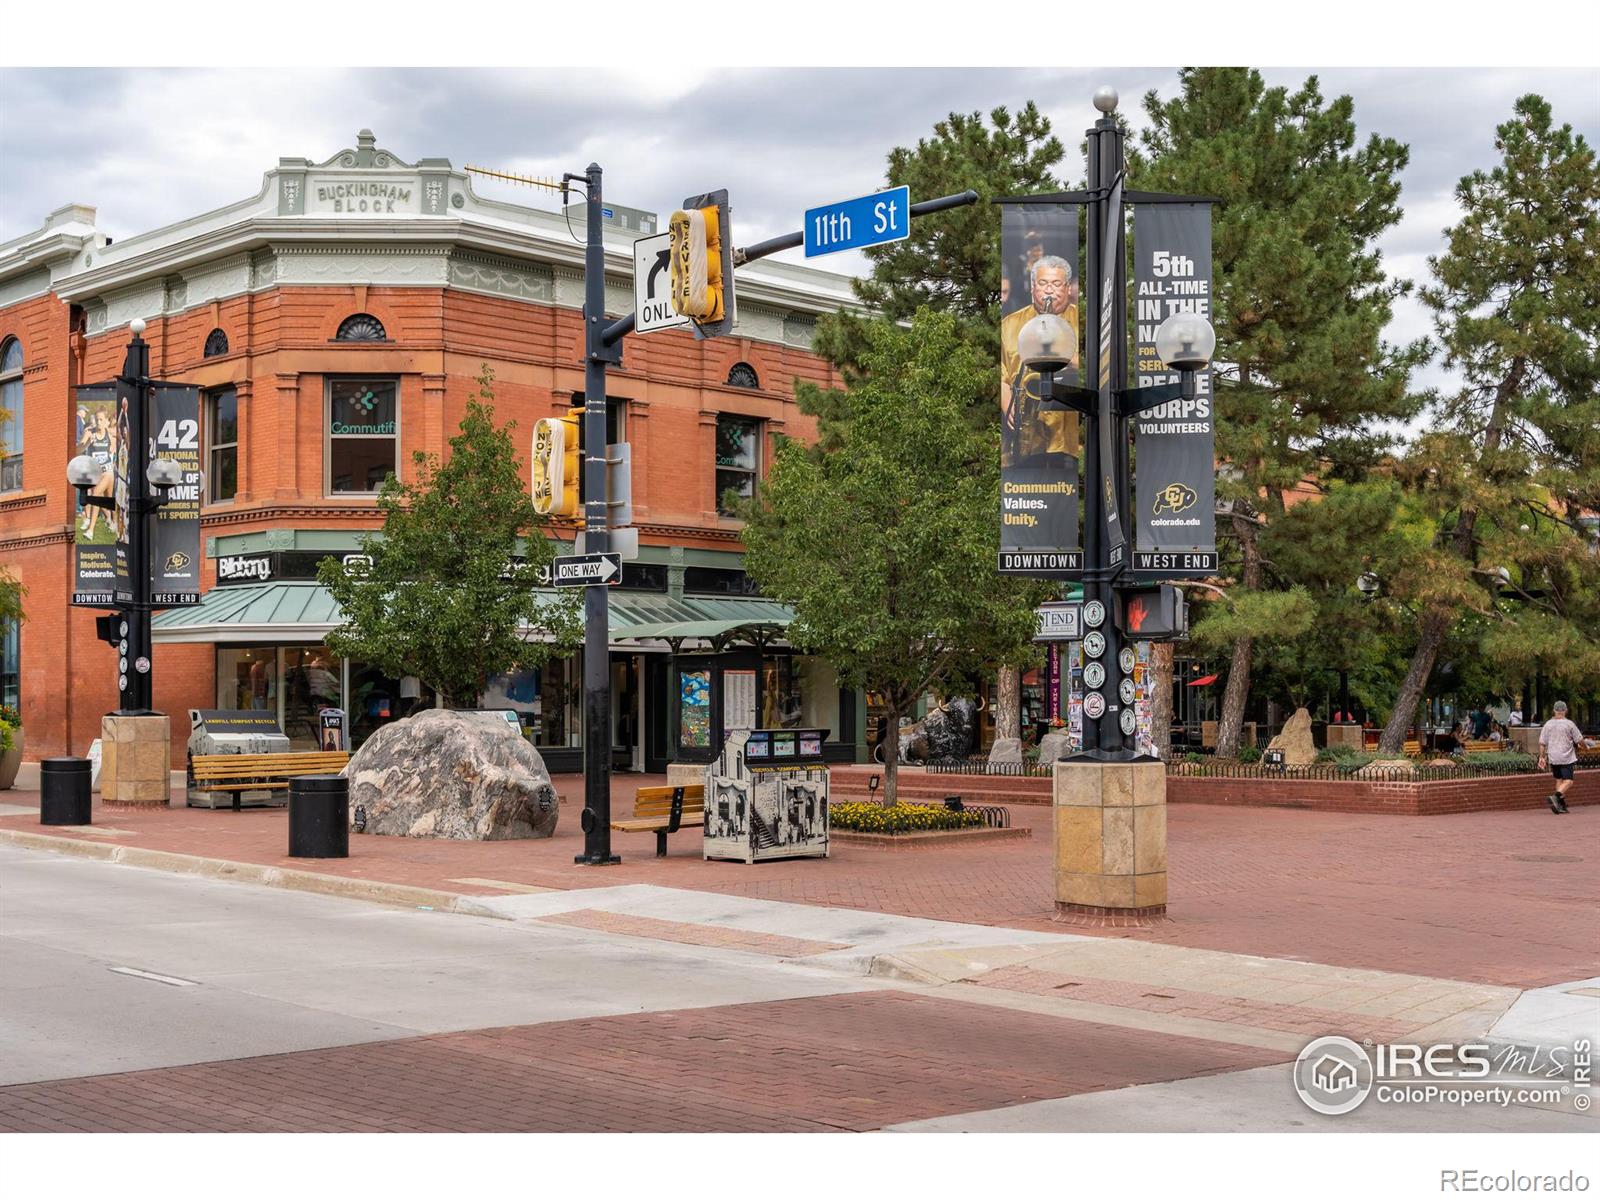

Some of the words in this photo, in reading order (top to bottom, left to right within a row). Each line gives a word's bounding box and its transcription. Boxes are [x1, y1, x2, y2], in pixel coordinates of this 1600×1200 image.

[318, 183, 412, 203] BUCKINGHAM
[334, 200, 395, 213] BLOCK
[815, 211, 851, 246] 11th
[874, 199, 897, 233] St
[1153, 251, 1194, 277] 5th
[1138, 280, 1208, 295] ALL-TIME
[643, 302, 679, 323] ONL
[1138, 299, 1160, 320] IN
[1166, 298, 1209, 319] THE
[1139, 347, 1156, 355] FOR
[158, 419, 198, 449] 42
[1139, 422, 1210, 434] VOLUNTEERS
[158, 451, 198, 460] NATIONAL
[178, 462, 198, 471] ORLD
[186, 474, 199, 483] OF
[1004, 481, 1076, 496] Community.
[1004, 497, 1048, 509] Values.
[159, 511, 167, 519] 11
[169, 511, 199, 519] SPORTS
[1004, 513, 1038, 527] Unity.
[1151, 518, 1200, 526] colorado.edu
[80, 552, 106, 560] Inspire.
[1005, 554, 1076, 568] DOWNTOWN
[1141, 554, 1177, 568] WEST
[1184, 554, 1209, 568] END
[80, 561, 112, 569] Motivate.
[561, 565, 578, 577] ONE
[582, 563, 600, 576] WAY
[80, 570, 115, 578] Celebrate.
[76, 594, 113, 602] DOWNTOW
[155, 594, 176, 602] WEST
[180, 594, 196, 602] END
[1051, 613, 1074, 624] END
